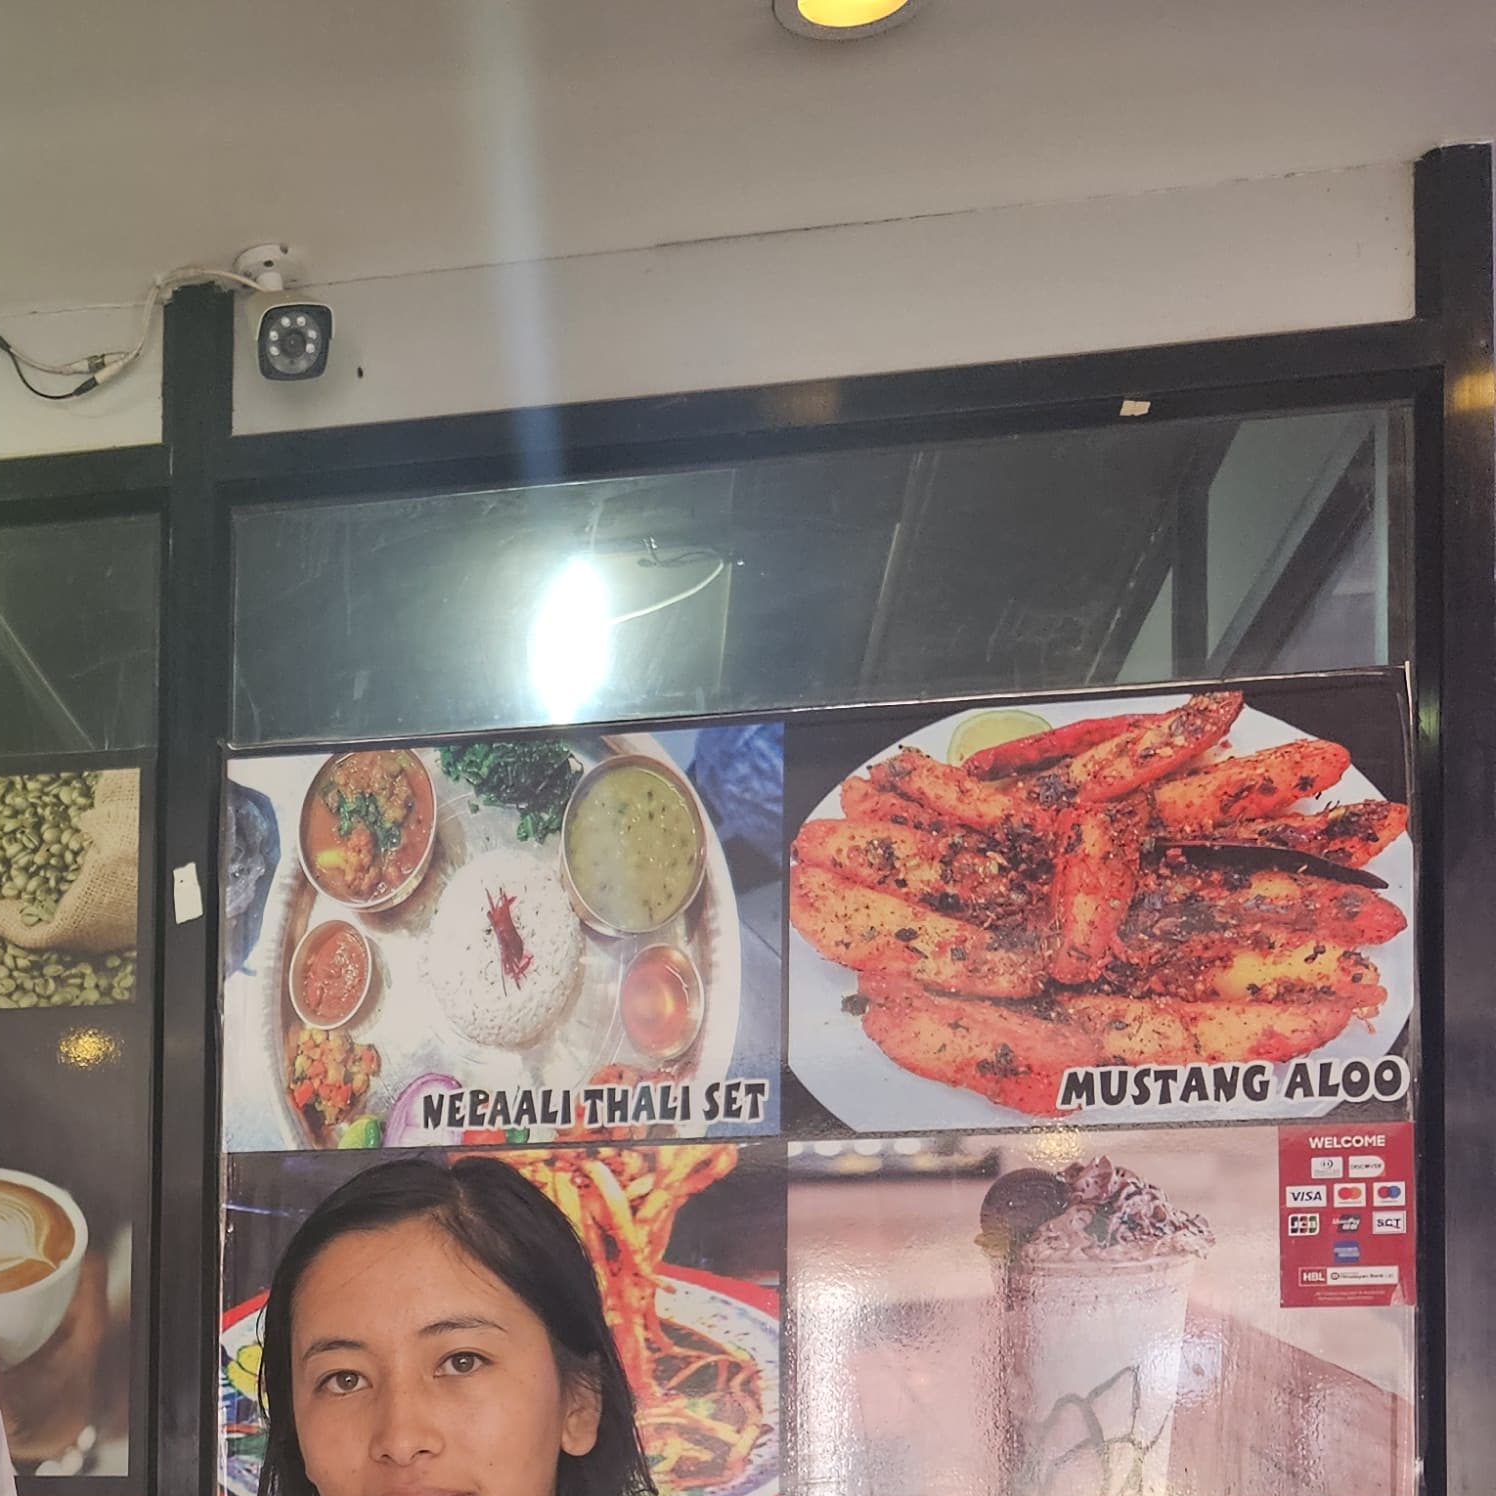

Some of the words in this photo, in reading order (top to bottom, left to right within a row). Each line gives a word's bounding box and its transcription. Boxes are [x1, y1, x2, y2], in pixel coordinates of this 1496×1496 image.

[1060, 1064, 1271, 1107] MUSTANG
[1284, 1059, 1406, 1099] ALOO
[421, 1088, 573, 1131] NEPAALI
[584, 1084, 692, 1124] THALI
[703, 1080, 767, 1121] SET
[1308, 1134, 1386, 1149] WELCOME
[1290, 1191, 1322, 1202] VISA
[1303, 1271, 1325, 1282] HBL
